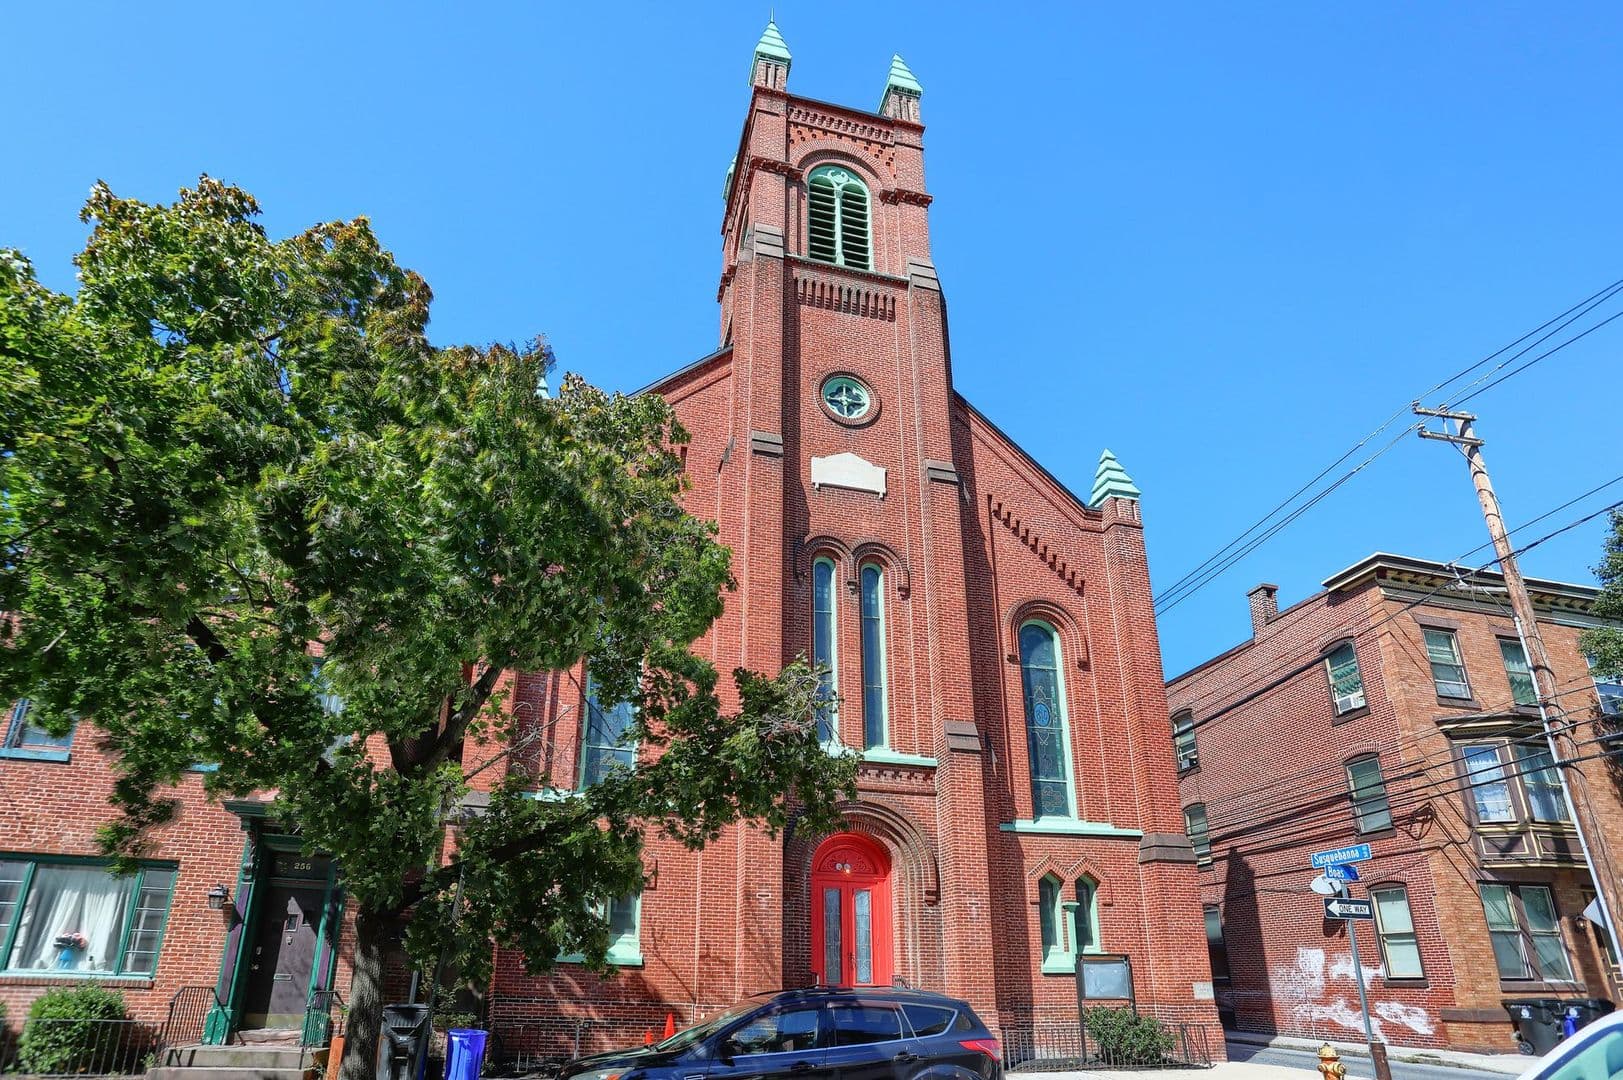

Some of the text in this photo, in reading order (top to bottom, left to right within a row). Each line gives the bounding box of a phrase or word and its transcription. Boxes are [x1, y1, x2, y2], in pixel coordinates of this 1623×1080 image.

[1314, 848, 1359, 864] Susquehanna
[294, 862, 311, 870] 256
[1328, 866, 1344, 877] Boas
[1339, 904, 1367, 913] ONE WAY
